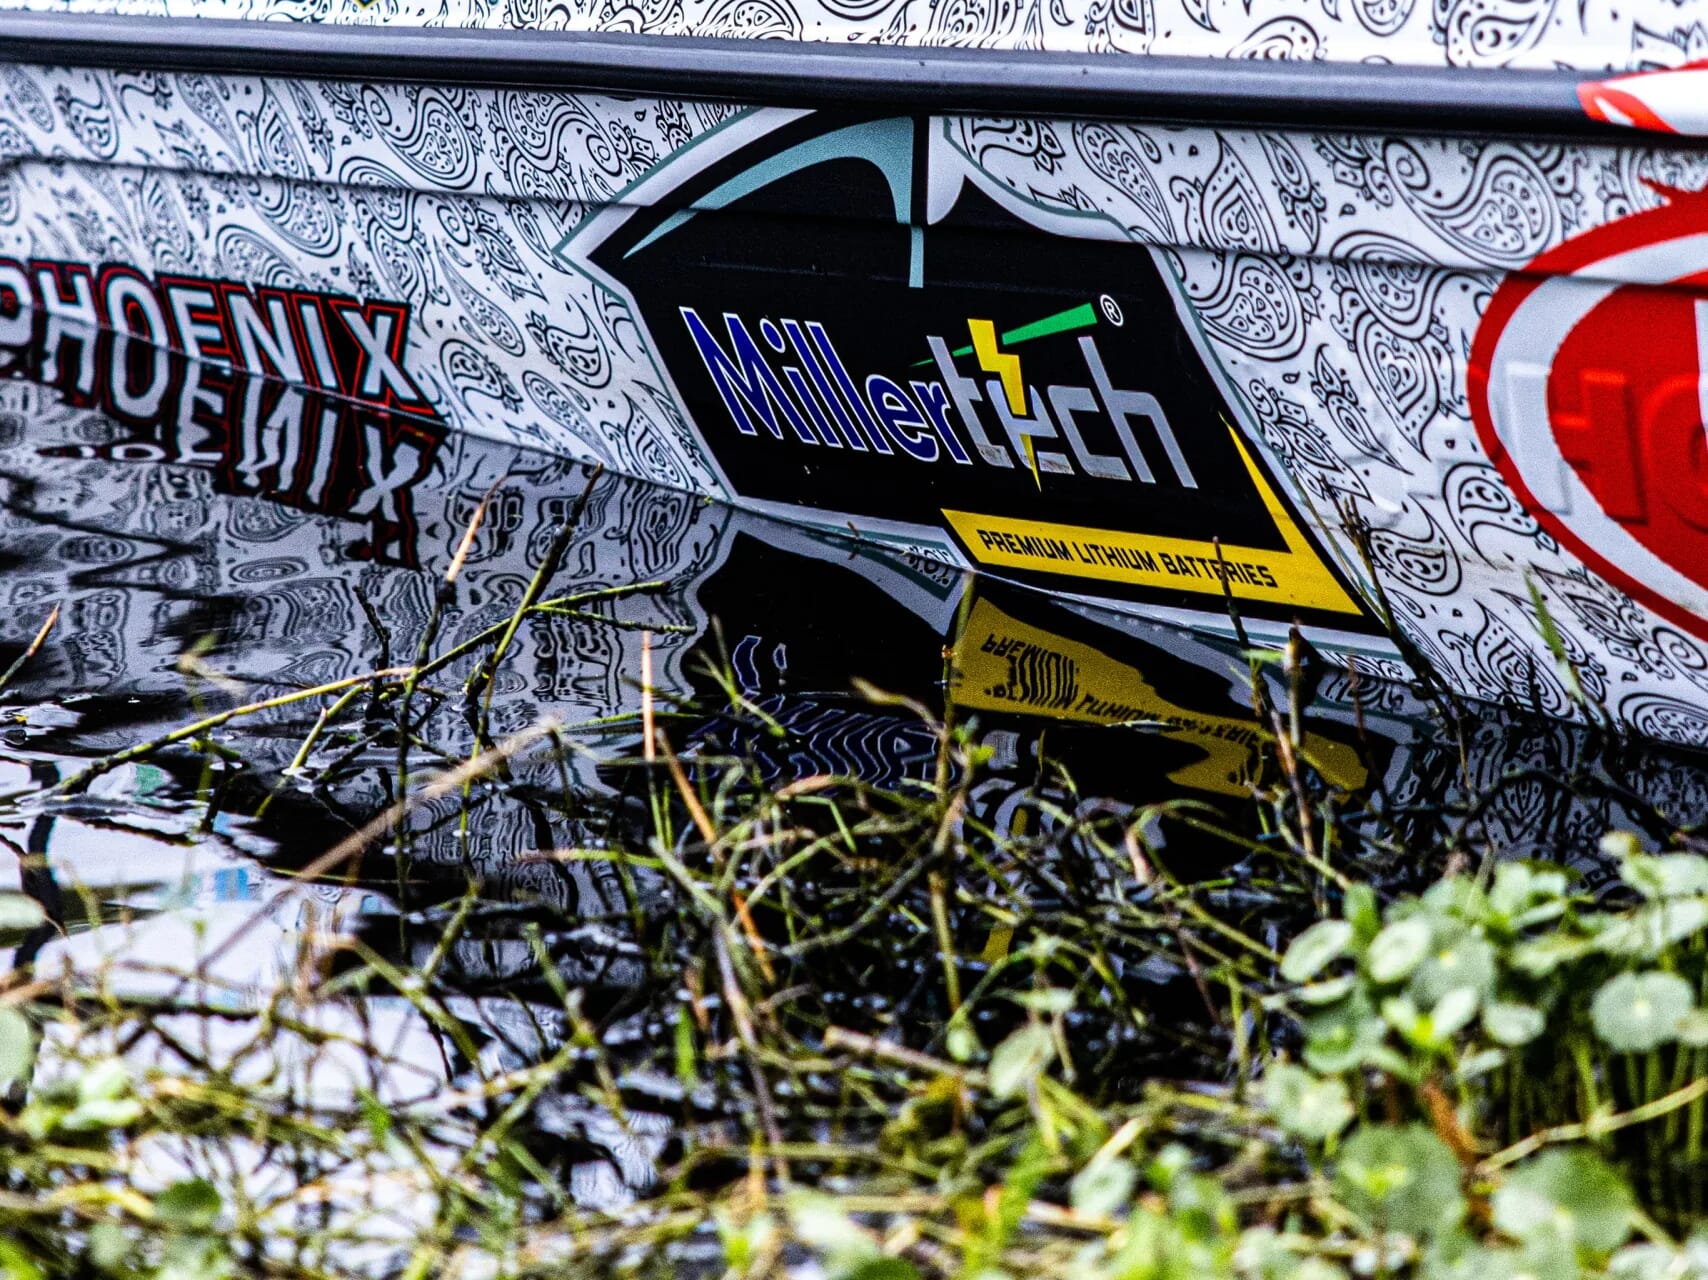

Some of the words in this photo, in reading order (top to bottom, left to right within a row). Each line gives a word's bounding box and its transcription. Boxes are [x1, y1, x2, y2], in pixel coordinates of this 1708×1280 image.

[976, 529, 1074, 562] PREMIUM
[1071, 541, 1161, 573] LITHIUM
[1158, 552, 1279, 588] BATTERIES
